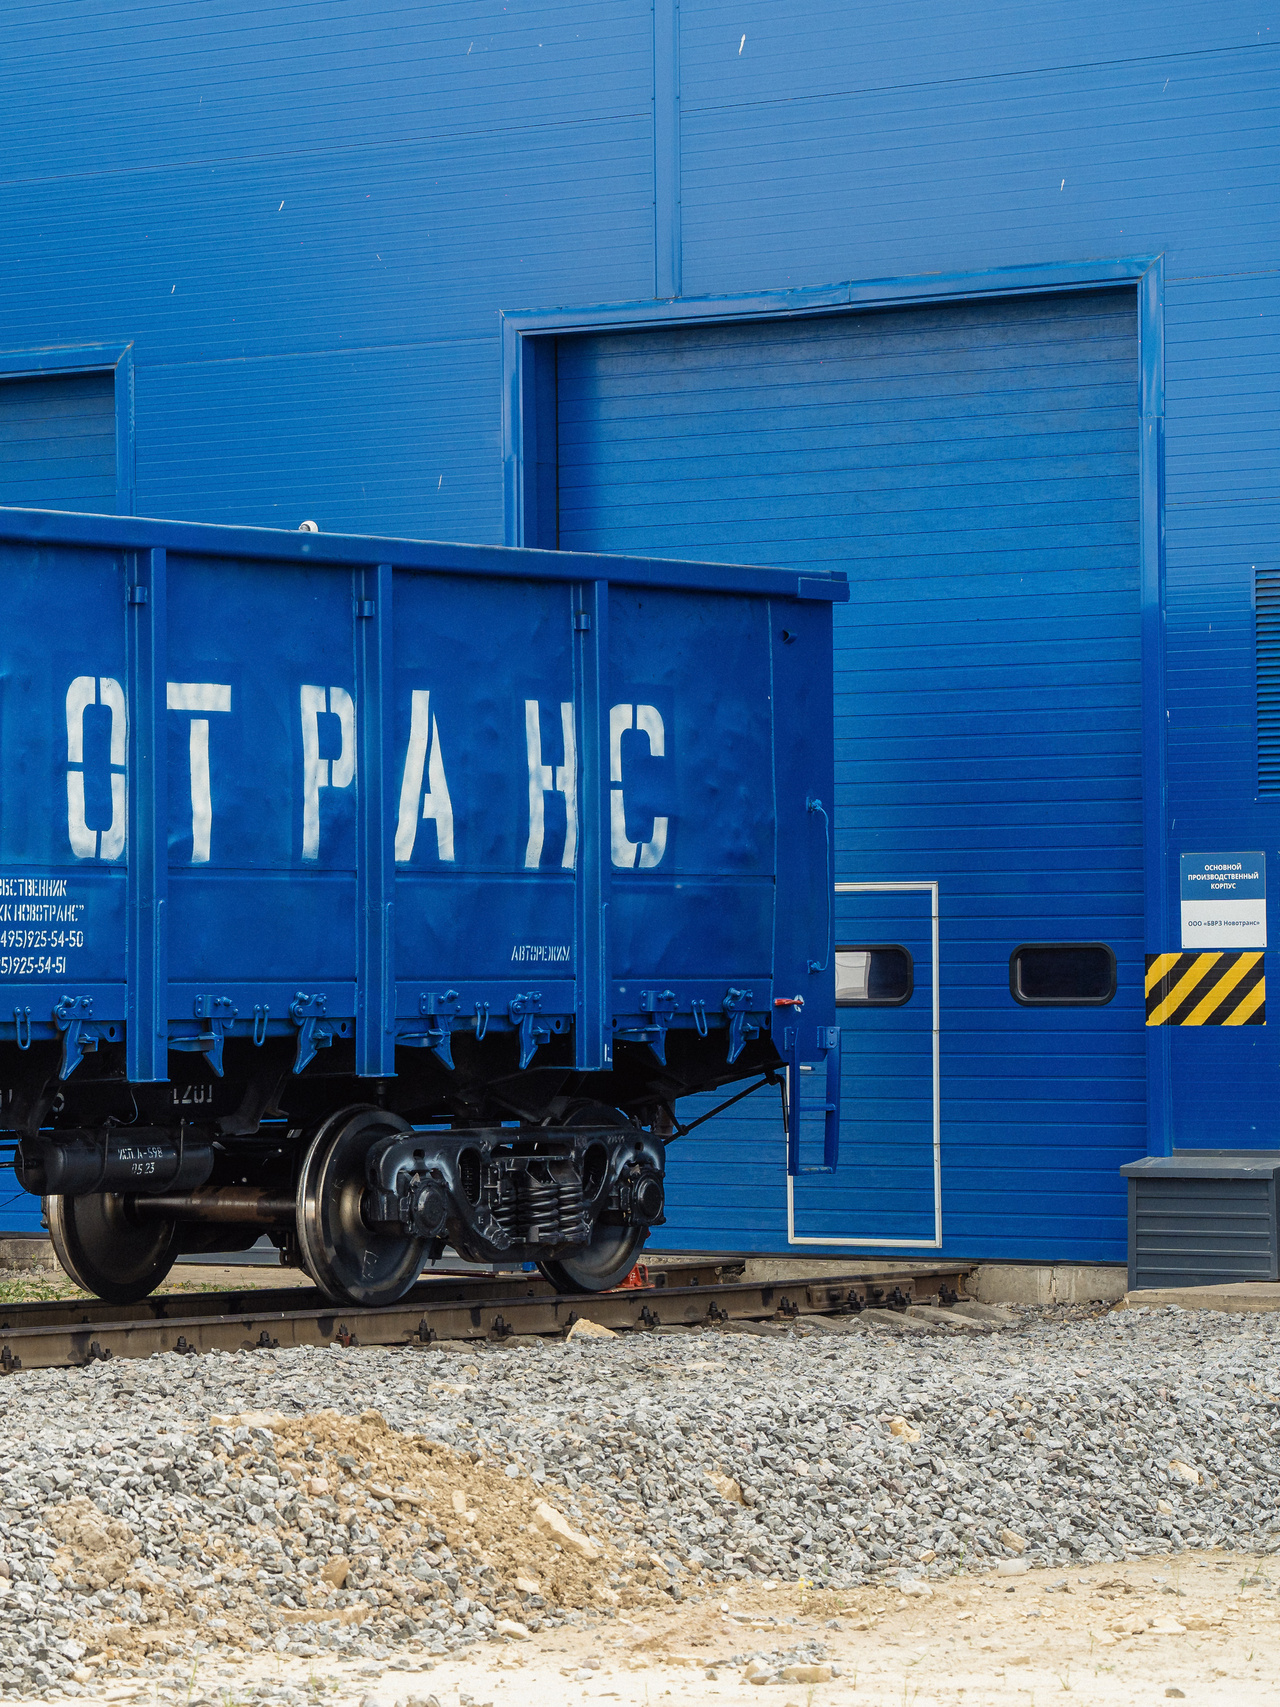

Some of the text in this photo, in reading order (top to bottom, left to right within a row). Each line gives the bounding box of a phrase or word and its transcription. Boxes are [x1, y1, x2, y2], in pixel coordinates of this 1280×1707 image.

[1204, 863, 1242, 871] ОСНОВНОЙ
[1187, 872, 1259, 881] ПРОИЗВОДСТВЕННЫЙ
[1210, 882, 1236, 890] КОРПУС
